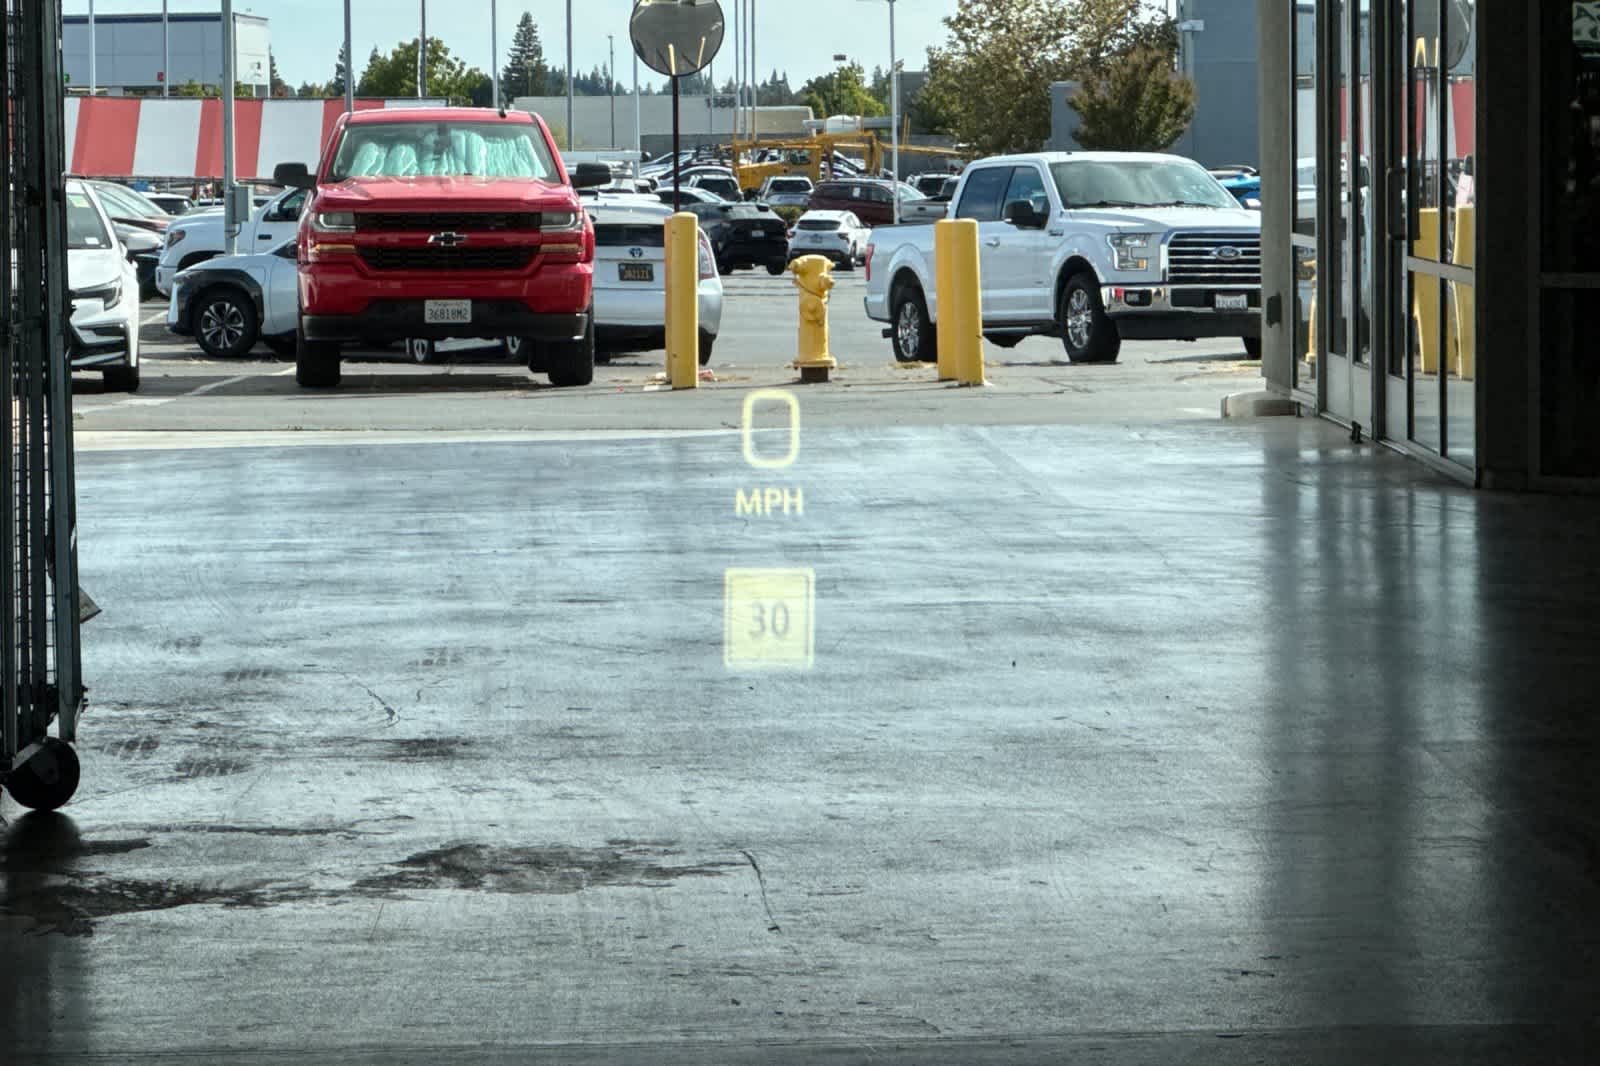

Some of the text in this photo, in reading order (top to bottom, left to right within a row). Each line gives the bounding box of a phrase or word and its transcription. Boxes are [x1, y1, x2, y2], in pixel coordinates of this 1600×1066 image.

[742, 389, 801, 469] 0
[735, 487, 804, 516] MPH
[748, 602, 790, 639] 30
